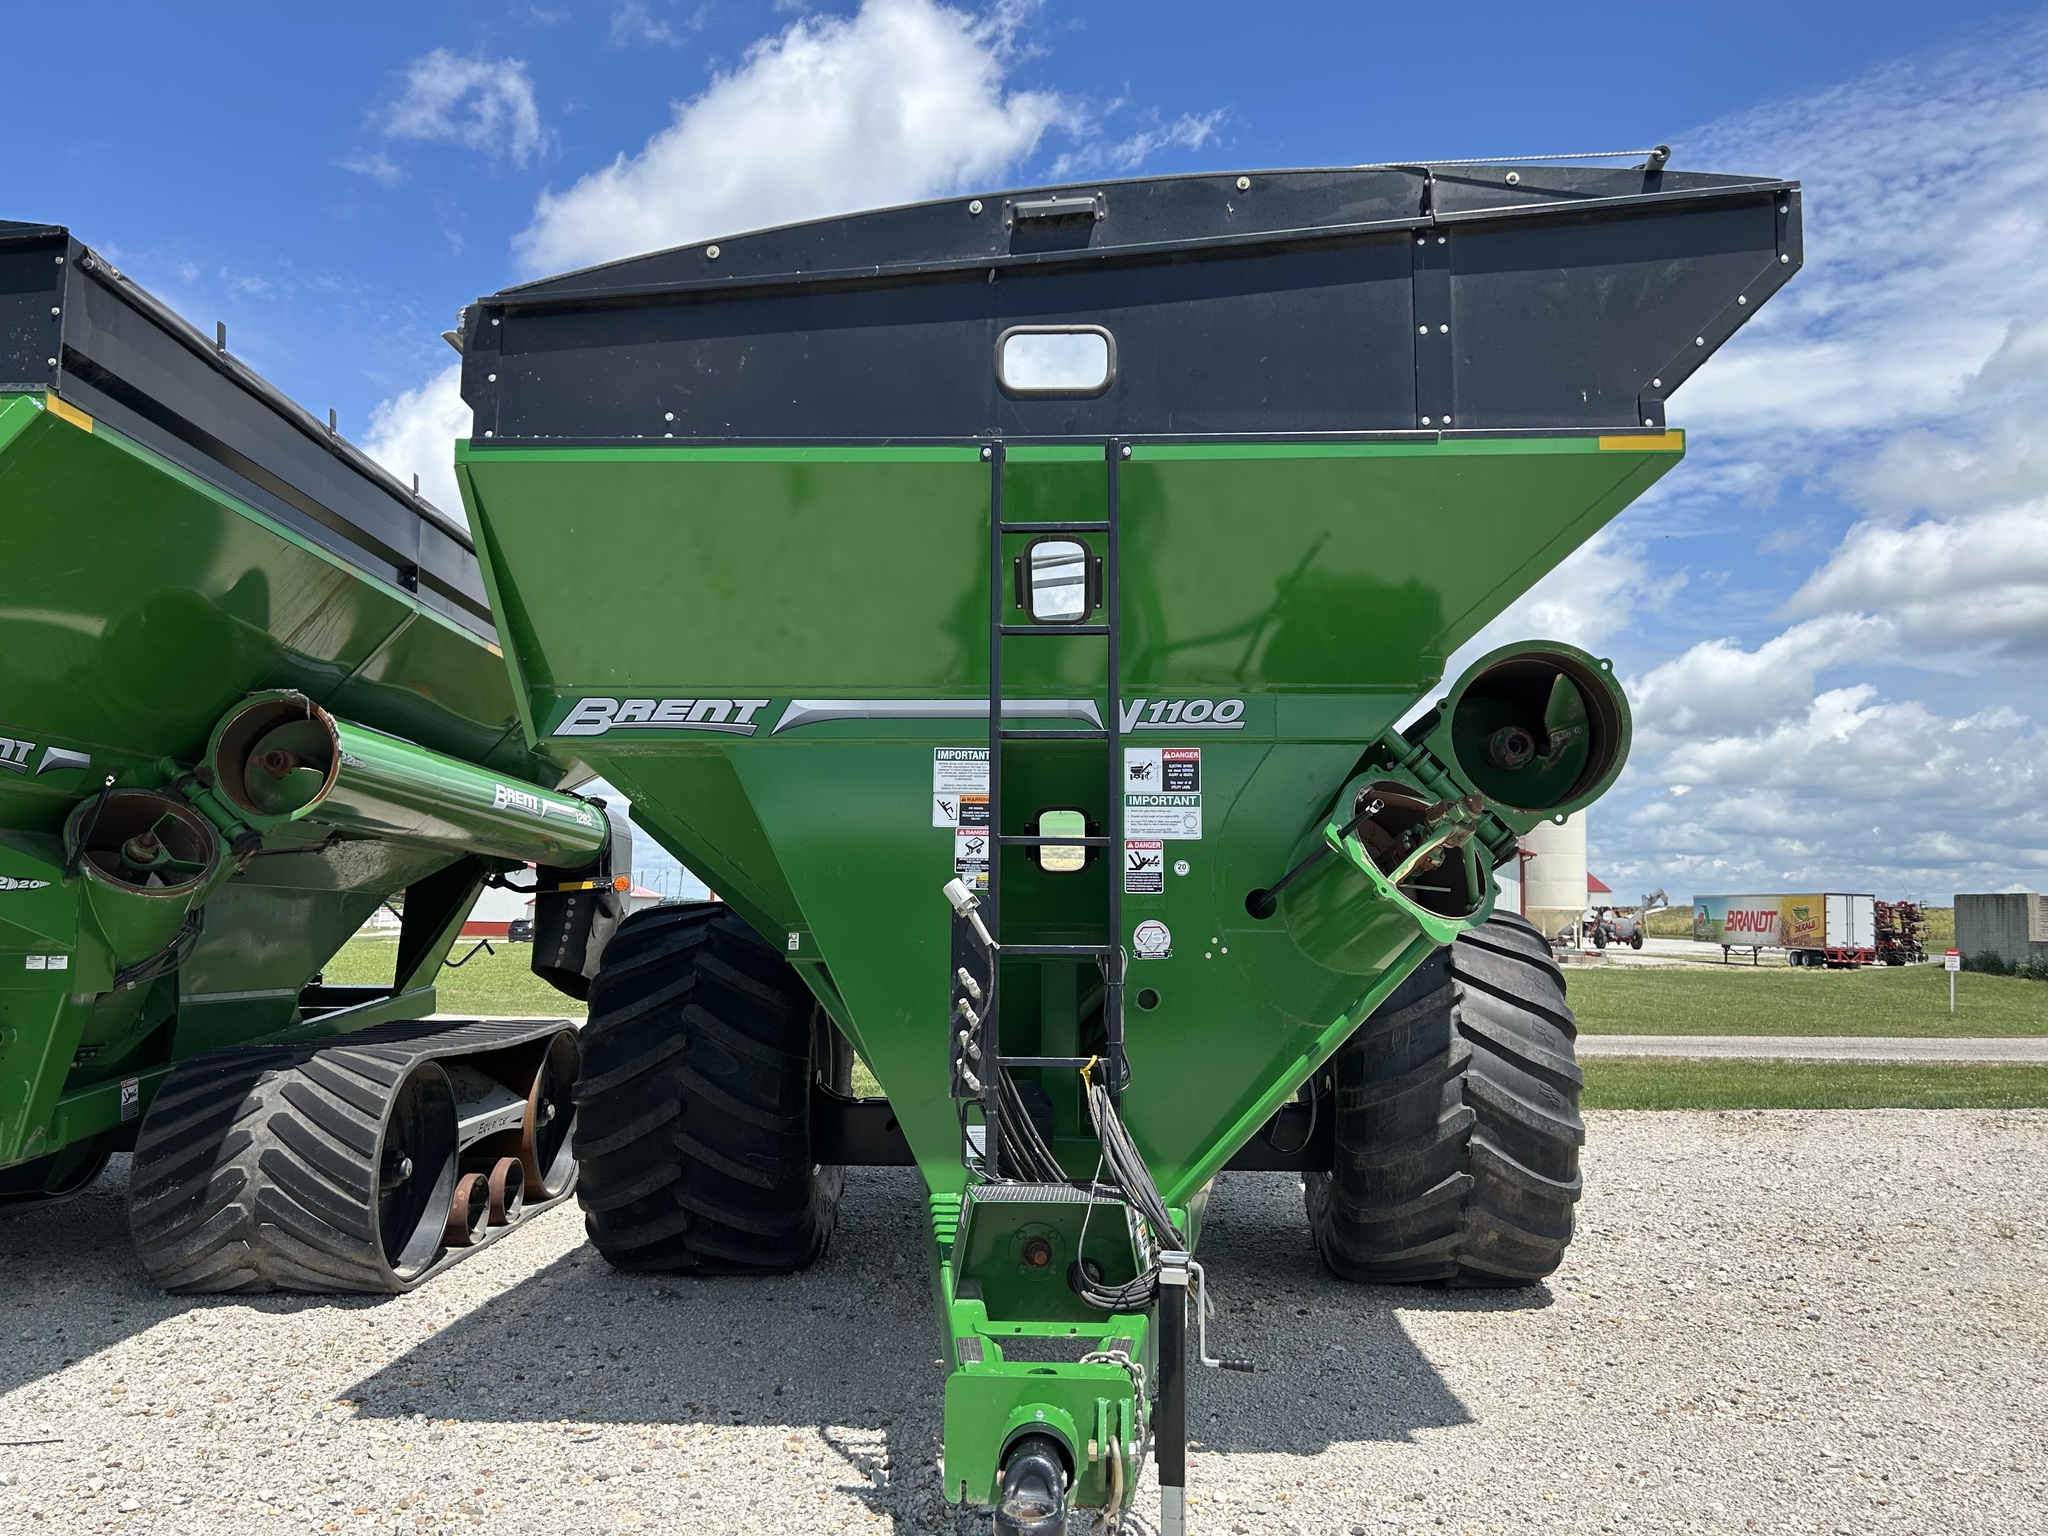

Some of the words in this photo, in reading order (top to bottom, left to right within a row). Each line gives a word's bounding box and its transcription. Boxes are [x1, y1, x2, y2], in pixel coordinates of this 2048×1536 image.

[551, 697, 770, 736] BRENT
[1170, 751, 1199, 759] DANGER
[492, 783, 539, 811] BRENT
[1128, 795, 1197, 806] IMPORTANT
[1134, 841, 1161, 849] DANGER
[1177, 863, 1187, 871] 20
[18, 880, 41, 889] 20
[1724, 910, 1778, 933] BRANDT
[1794, 920, 1817, 933] DEKALB
